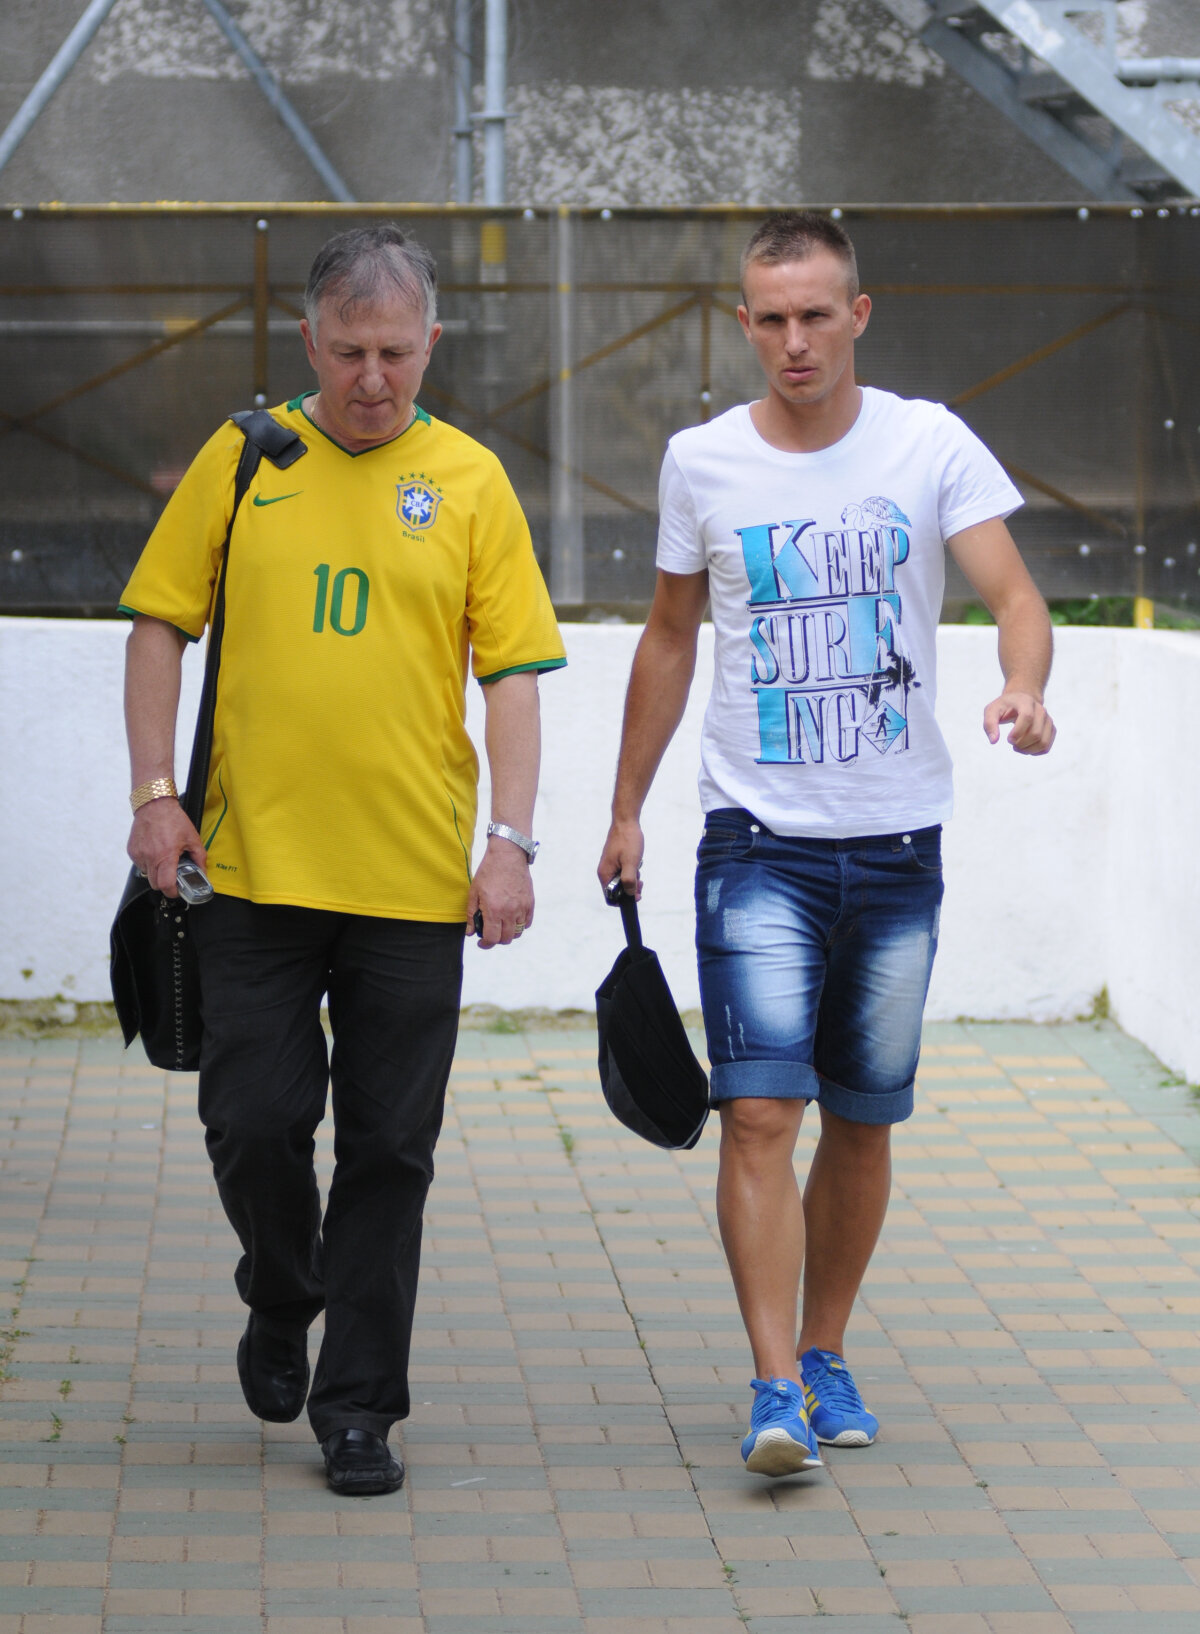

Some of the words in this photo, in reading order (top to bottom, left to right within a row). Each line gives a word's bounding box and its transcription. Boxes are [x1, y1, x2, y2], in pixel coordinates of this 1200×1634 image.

[402, 530, 425, 543] Brasil
[734, 519, 910, 604] KEEP
[313, 563, 370, 637] 10
[750, 594, 902, 685] SURF
[750, 687, 860, 765] ING
